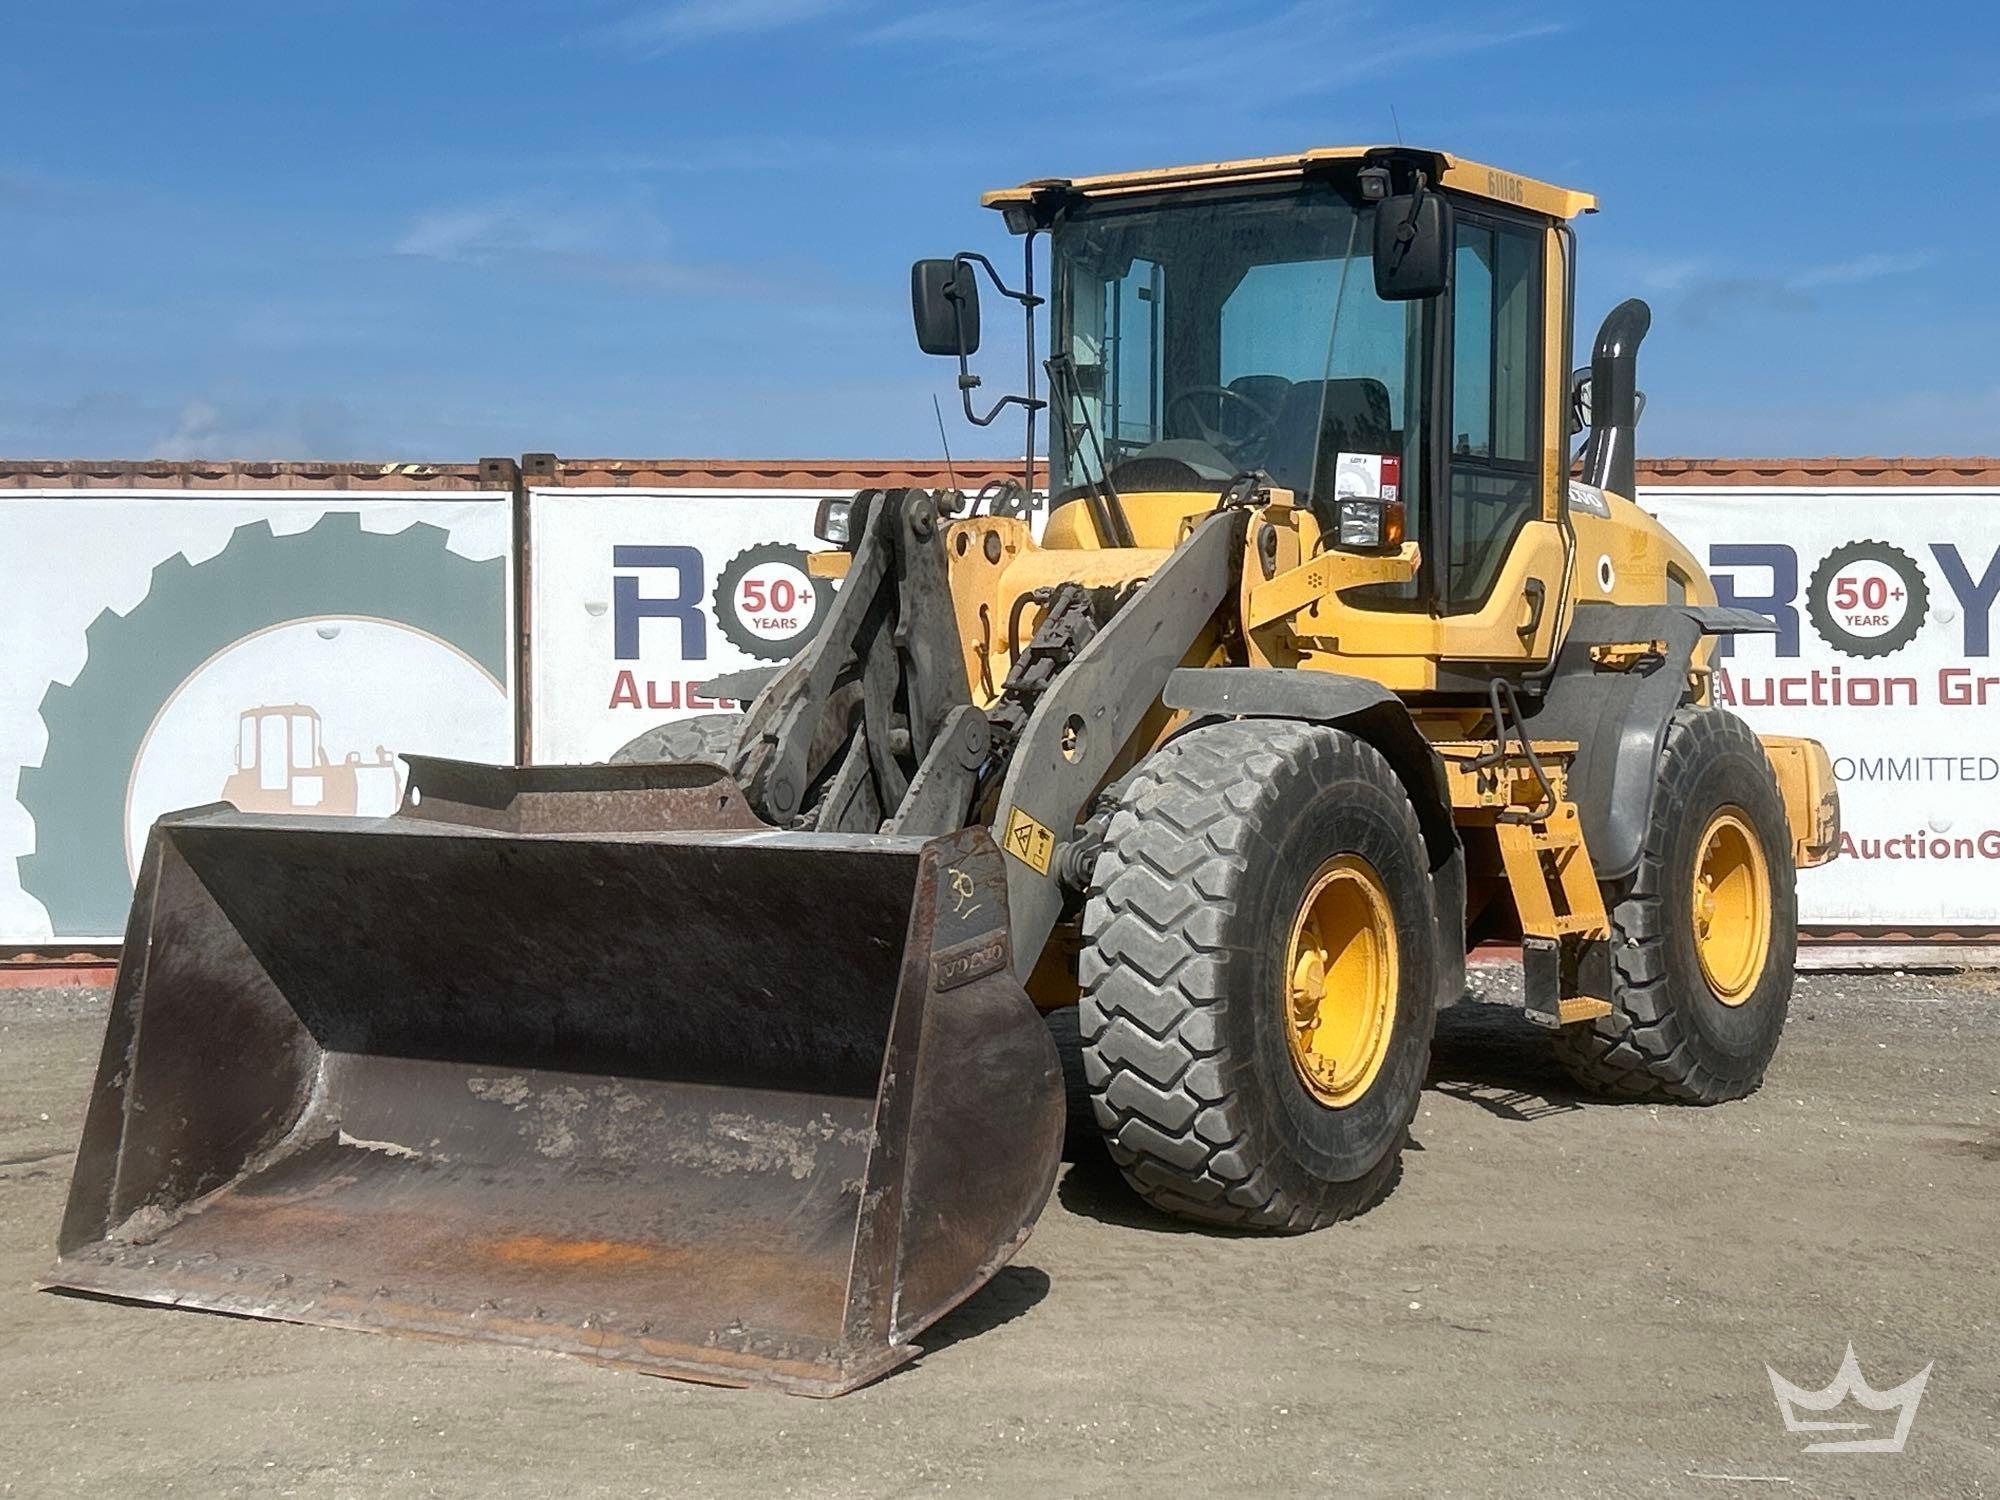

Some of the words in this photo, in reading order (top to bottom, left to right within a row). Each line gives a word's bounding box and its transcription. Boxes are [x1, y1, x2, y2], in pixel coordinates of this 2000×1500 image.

[742, 579, 813, 613] 50+
[1835, 577, 1904, 610] 50+
[752, 617, 798, 629] YEARS
[1845, 614, 1889, 626] YEARS
[1720, 666, 1918, 706] Auction
[1832, 757, 1999, 782] OMMITTED
